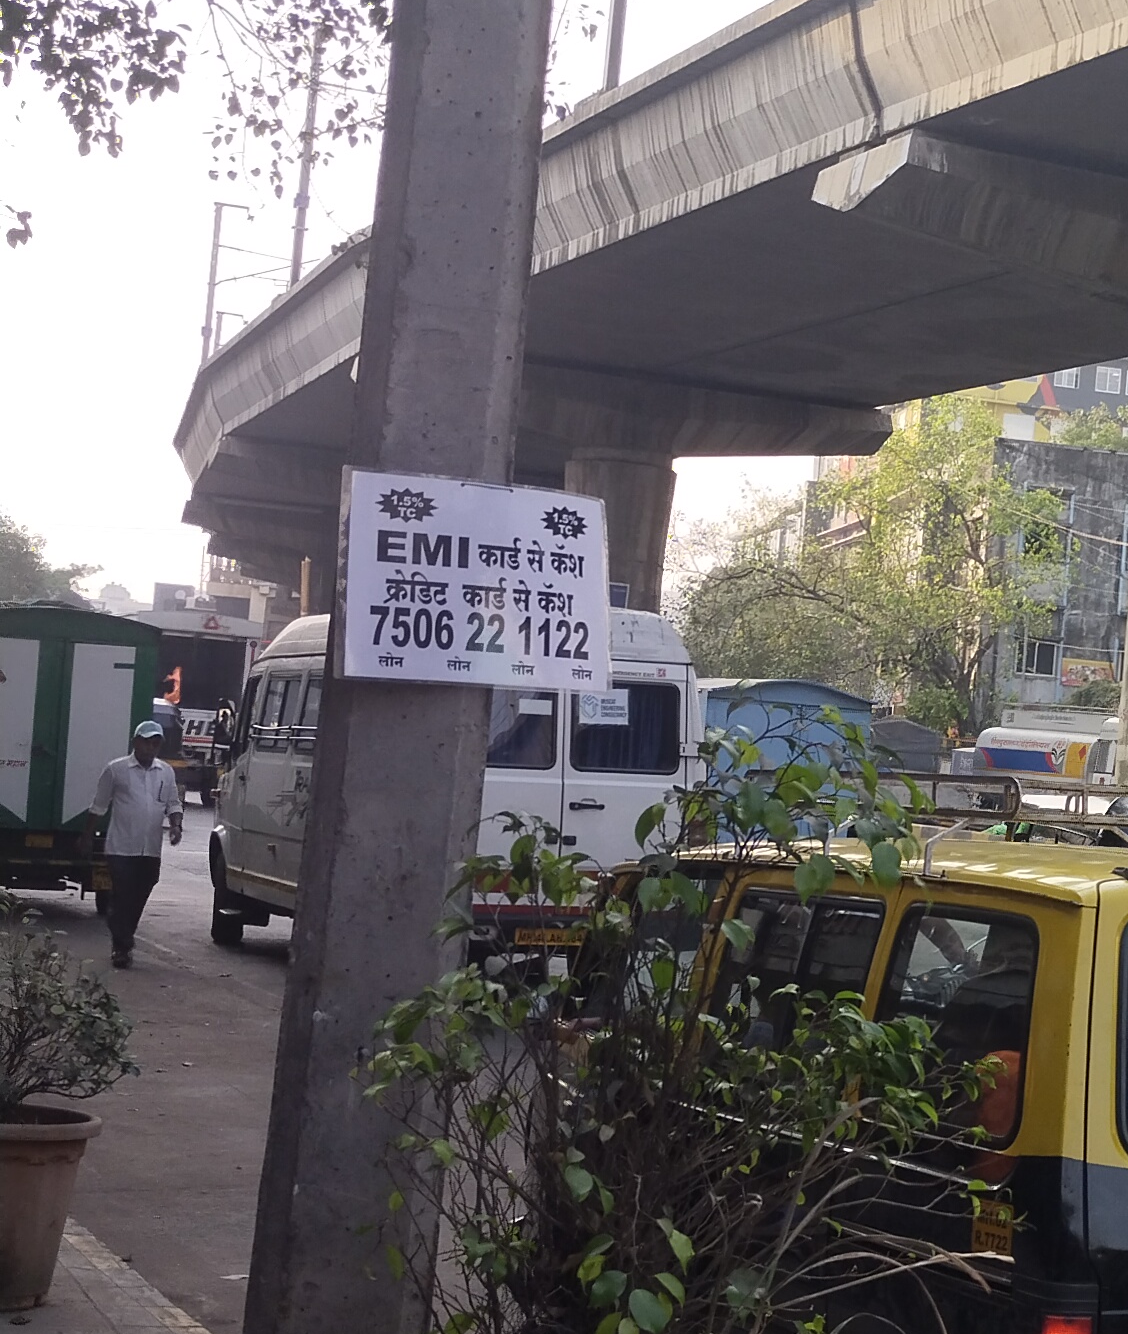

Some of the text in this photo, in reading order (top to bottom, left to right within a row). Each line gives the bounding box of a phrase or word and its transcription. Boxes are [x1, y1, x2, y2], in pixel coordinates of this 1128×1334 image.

[390, 495, 424, 509] 1.5%
[398, 507, 416, 518] TC
[552, 513, 578, 526] 1.5%
[558, 524, 573, 535] TC
[376, 529, 470, 569] EMI
[478, 537, 521, 570] कार्ड
[527, 540, 543, 573] से
[383, 569, 449, 605] क्रेडिट
[462, 577, 507, 610] कार्ड
[513, 580, 530, 613] से
[370, 605, 589, 660] 7506 22 1122
[378, 652, 592, 680] लोन लोन लोन लोन
